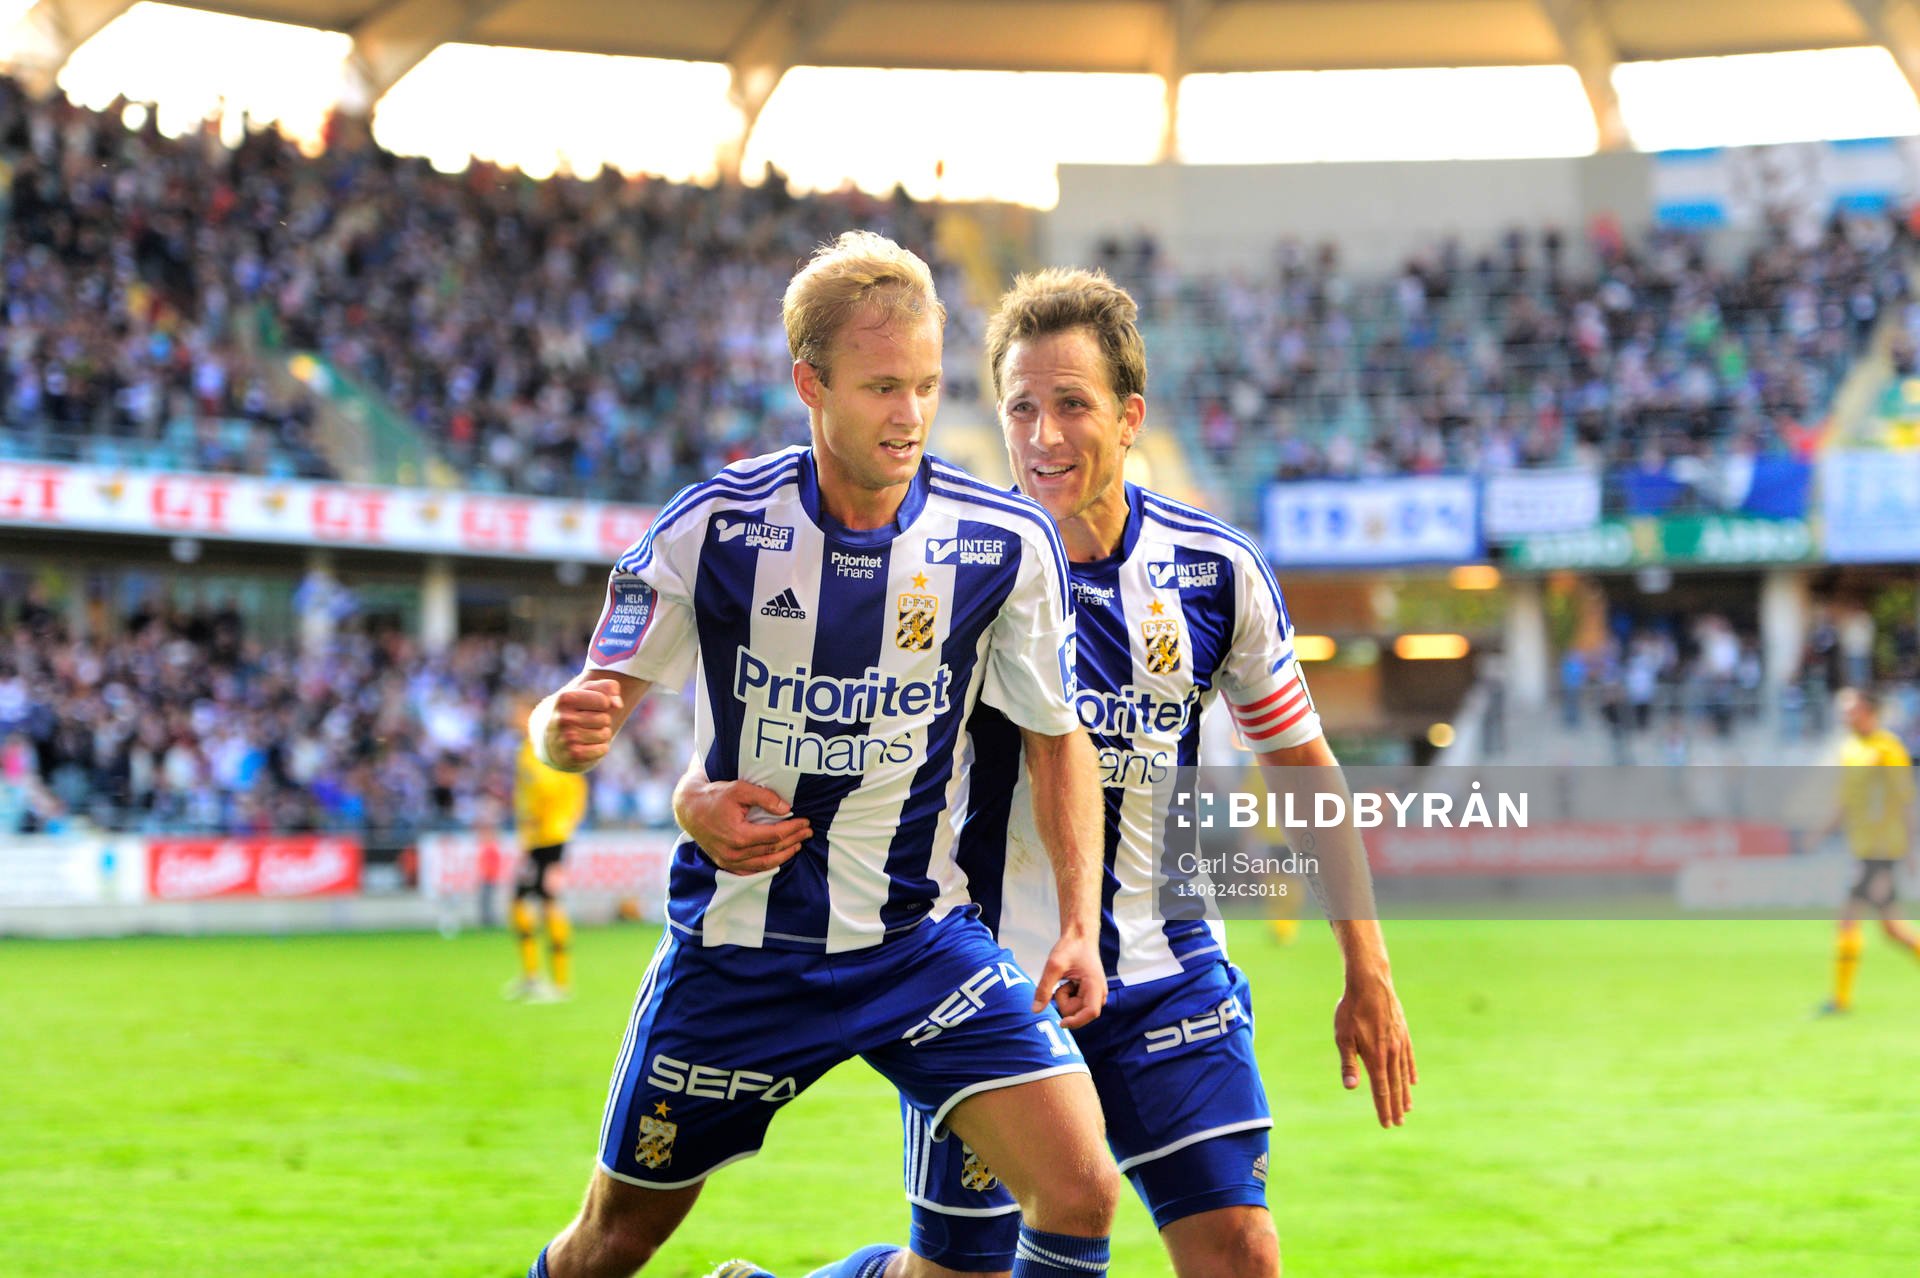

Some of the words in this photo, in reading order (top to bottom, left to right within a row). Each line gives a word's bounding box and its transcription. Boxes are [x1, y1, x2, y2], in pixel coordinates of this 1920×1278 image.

[747, 523, 789, 539] INTER
[745, 535, 788, 550] SPORT
[959, 539, 1003, 552] INTER
[831, 551, 883, 569] Prioritet
[959, 552, 1003, 565] SPORT
[836, 564, 875, 579] Finans
[1176, 562, 1218, 576] INTER
[1178, 573, 1218, 588] SPORT
[624, 594, 643, 604] HELA
[615, 604, 649, 615] SVERIGES
[760, 606, 806, 620] adidas
[609, 614, 647, 626] FOTBOLLS
[610, 624, 636, 634] KLUBB
[735, 646, 951, 723] Prioritet
[1074, 685, 1199, 738] oritet
[753, 715, 915, 775] Finans
[1099, 749, 1169, 786] ans
